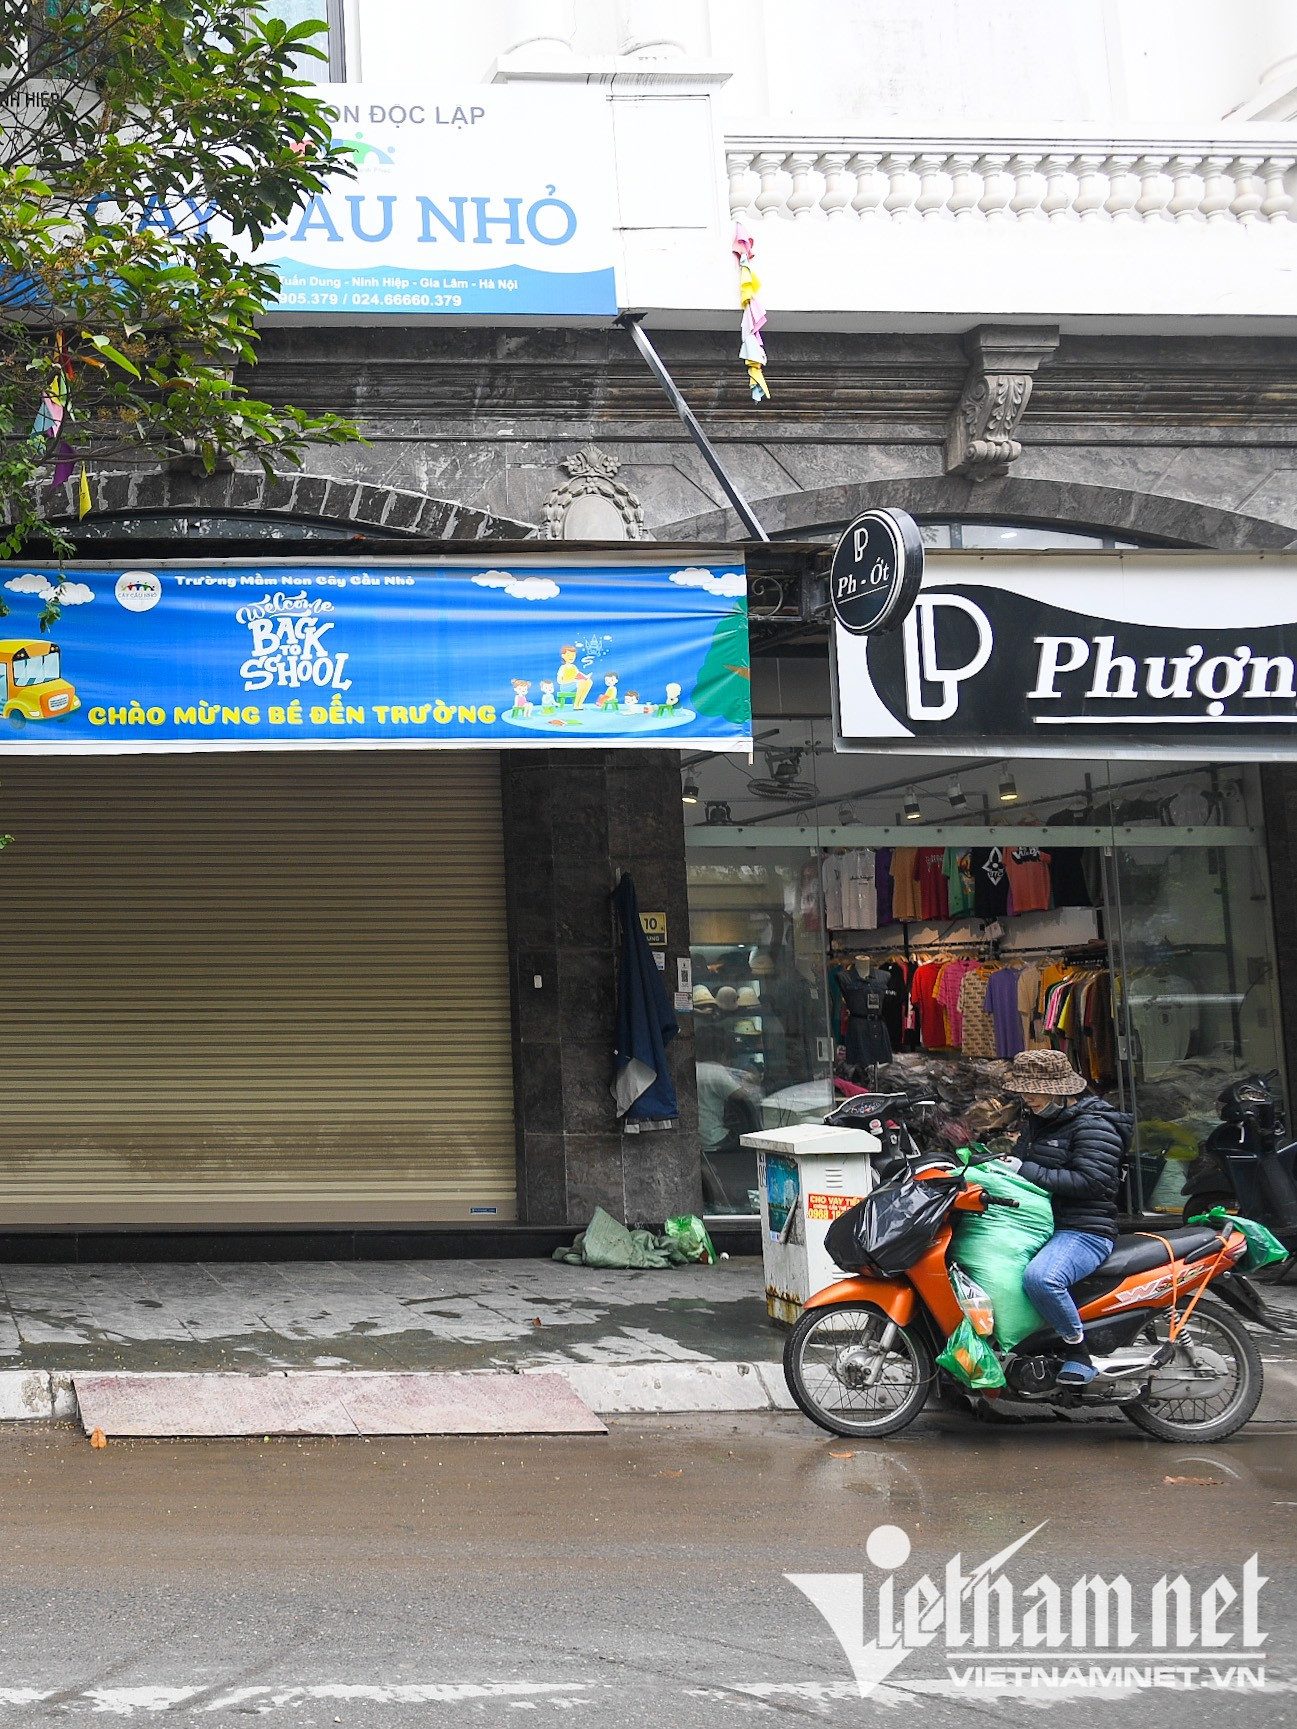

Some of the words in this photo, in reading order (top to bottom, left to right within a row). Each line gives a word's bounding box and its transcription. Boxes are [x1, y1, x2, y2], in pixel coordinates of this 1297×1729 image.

[368, 103, 426, 129] ĐỘC
[435, 104, 486, 130] LẬP
[418, 183, 578, 246] NHỎ
[309, 276, 342, 289] Dung
[352, 276, 380, 288] Ninh
[382, 276, 410, 290] Hiệp
[420, 277, 441, 288] Gia
[443, 276, 469, 289] Lâm
[479, 277, 495, 290] Hà
[497, 277, 519, 292] Nội
[351, 293, 463, 307] 024.66660.379
[174, 574, 236, 588] Trường
[240, 572, 278, 586] Mầm
[281, 575, 313, 586] Non
[315, 573, 347, 588] Cây
[349, 572, 381, 586] Cầu
[384, 575, 416, 586] Nhỏ
[836, 574, 857, 598] Ph
[235, 590, 335, 625] Welcome
[247, 617, 335, 661] BACK
[279, 643, 302, 656] TO
[239, 652, 353, 692] SCHOOL
[1026, 635, 1297, 718] Phượn
[88, 699, 167, 726] CHÀO
[173, 699, 261, 726] MỪNG
[268, 698, 304, 726] BÉ
[308, 692, 366, 726] ĐẾN
[371, 699, 497, 726] TRƯỜNG
[828, 1197, 844, 1205] VAY
